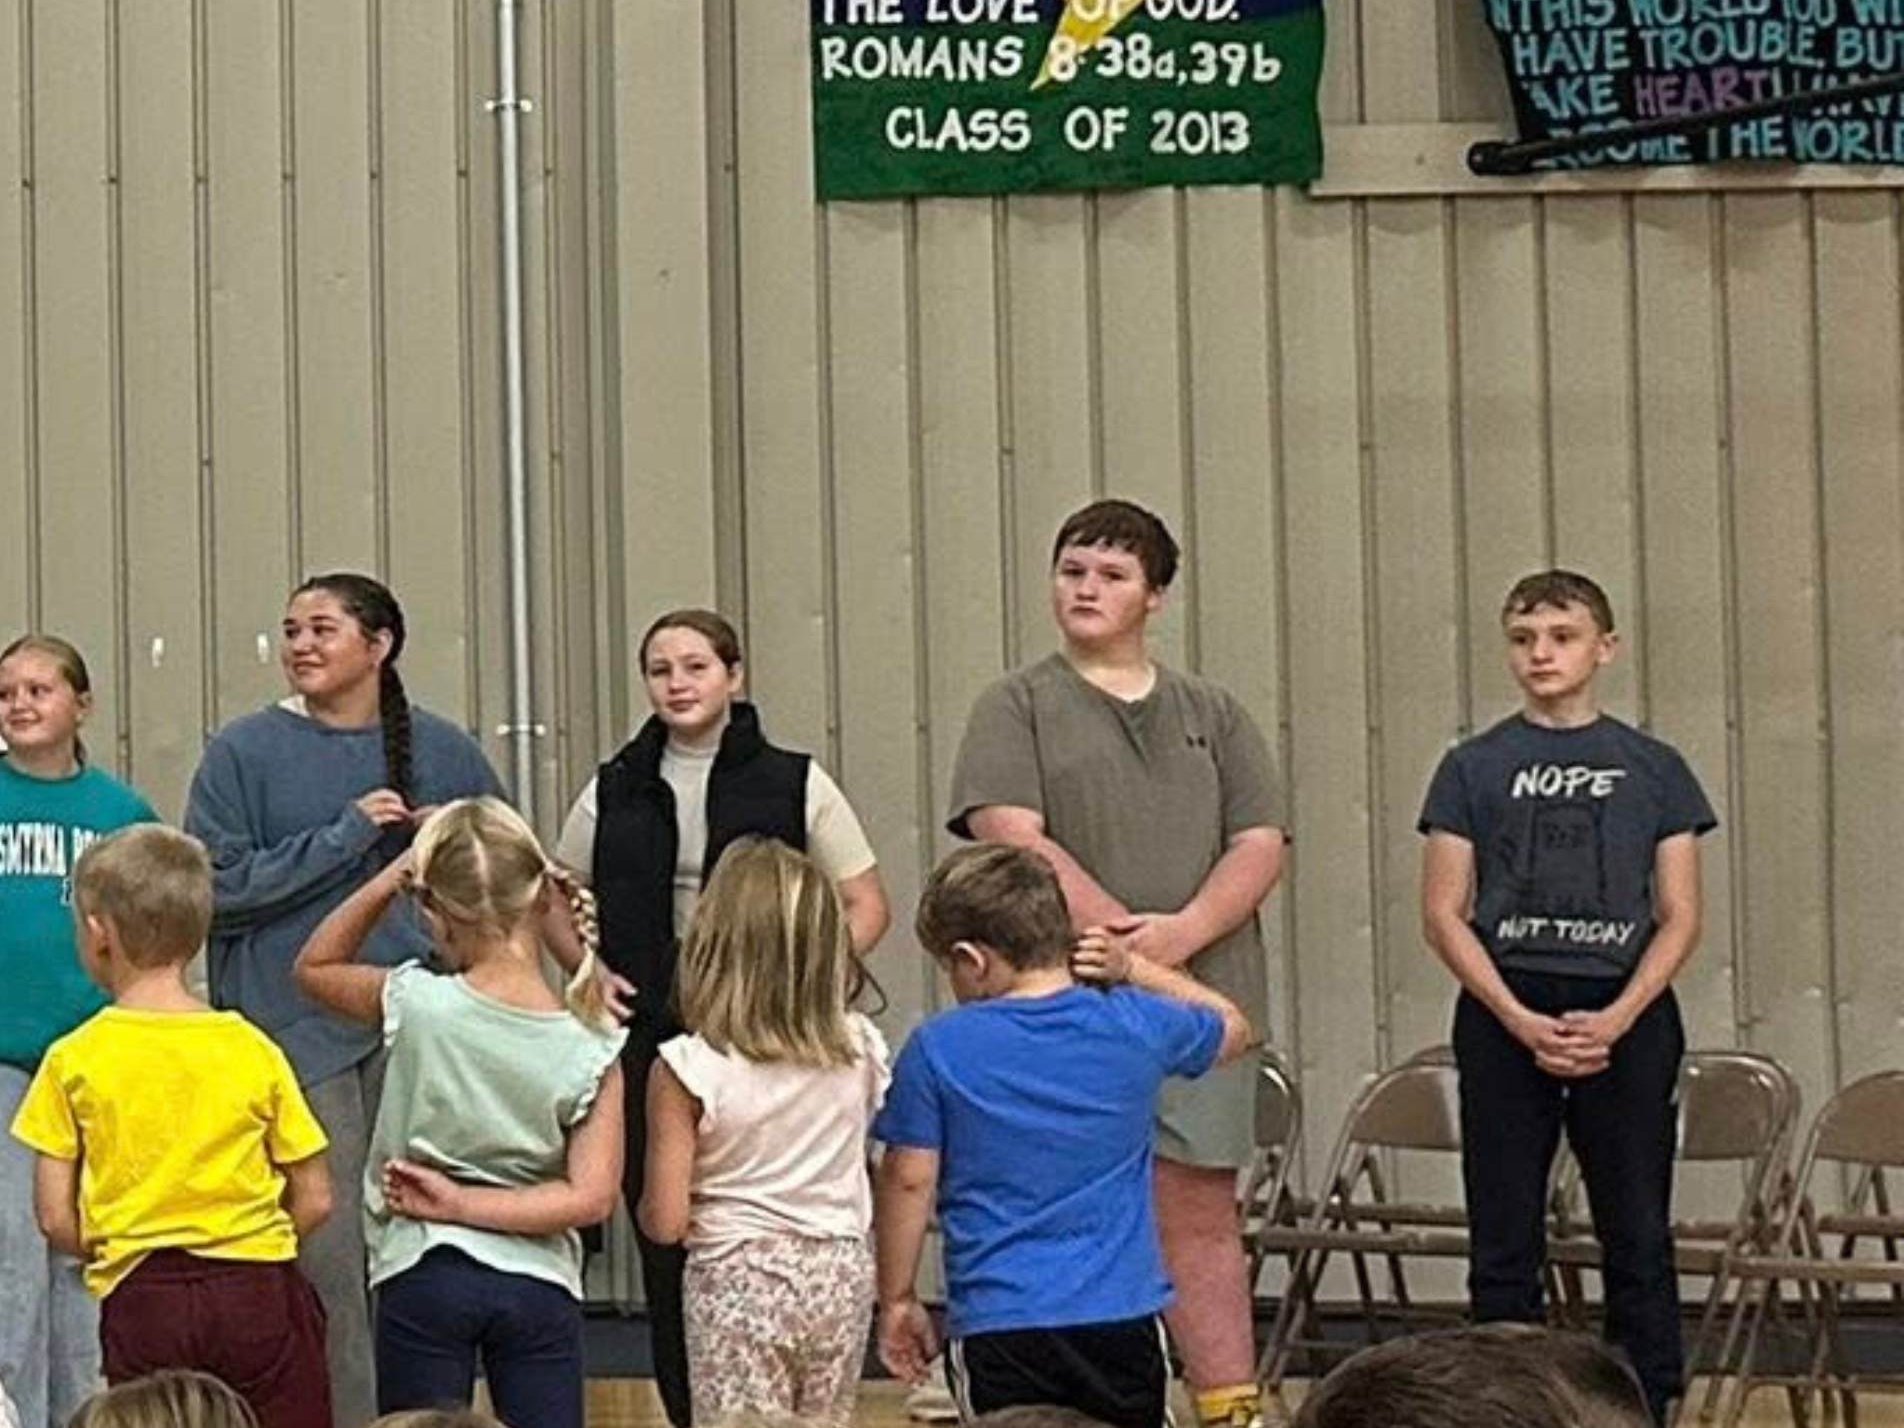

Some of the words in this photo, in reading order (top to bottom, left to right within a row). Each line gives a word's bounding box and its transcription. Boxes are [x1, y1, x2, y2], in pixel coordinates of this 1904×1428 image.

[823, 36, 1023, 79] ROMANS
[1514, 29, 1631, 75] HAVE
[886, 106, 1032, 150] CLASS
[1065, 107, 1129, 150] OF
[1151, 109, 1250, 152] 2013
[1512, 762, 1627, 799] NOPE
[1553, 917, 1635, 946] TODAY
